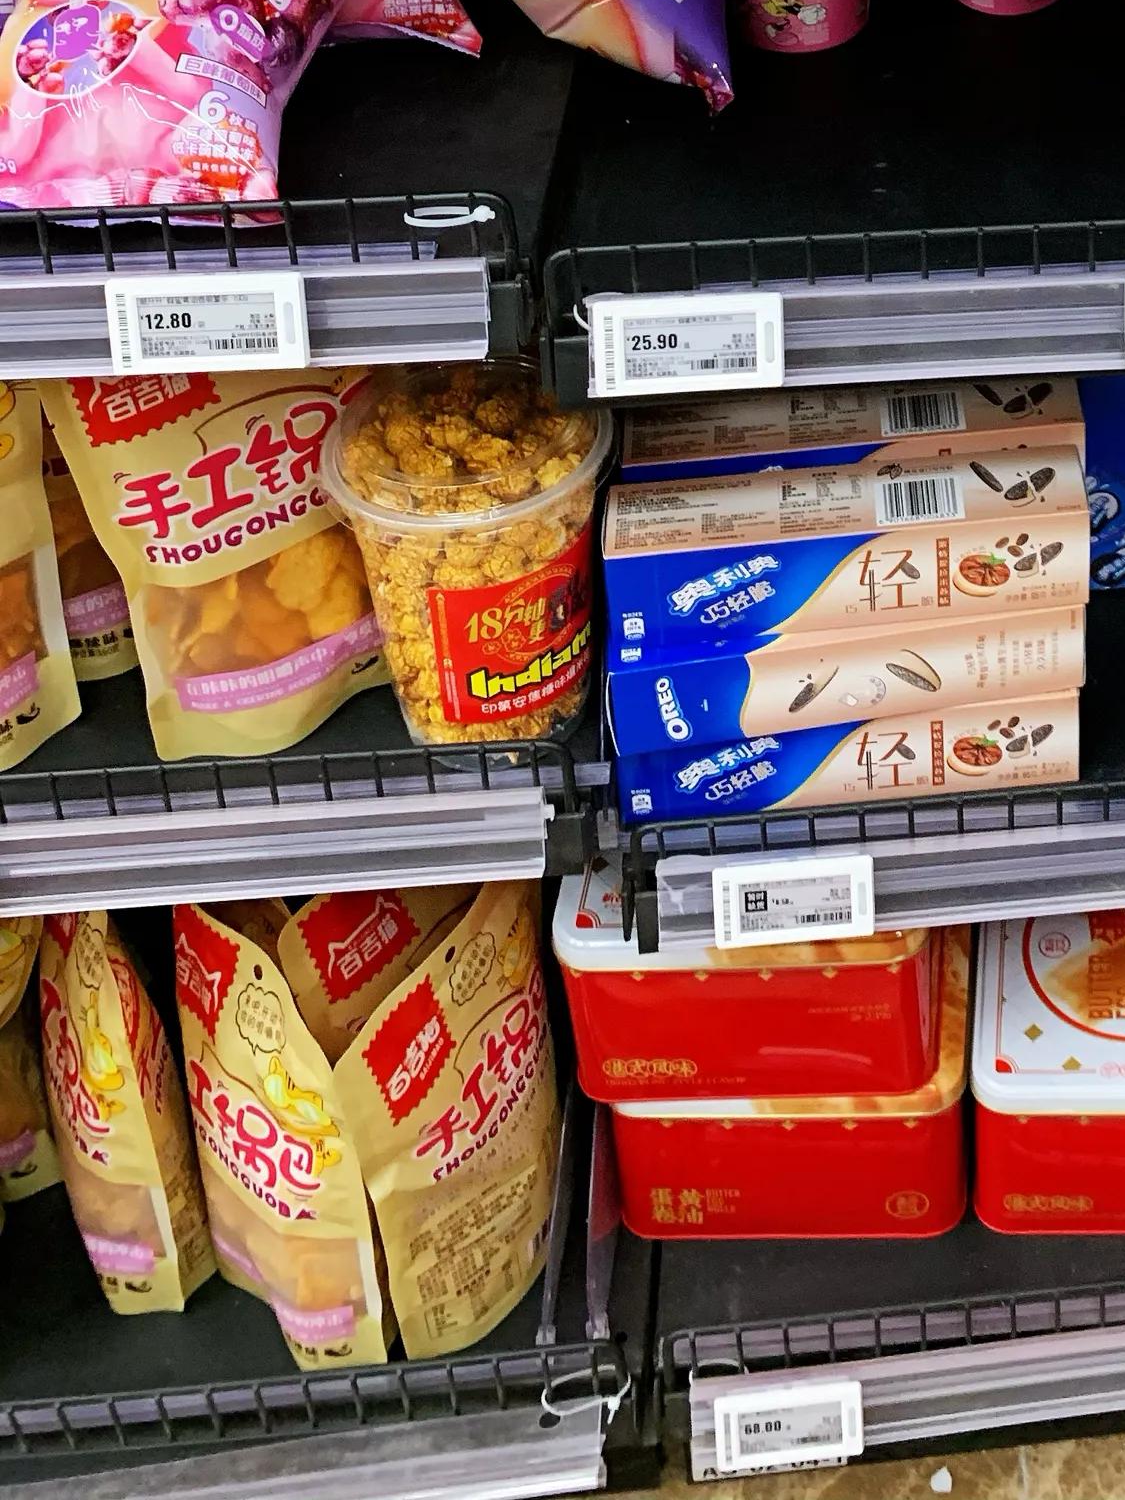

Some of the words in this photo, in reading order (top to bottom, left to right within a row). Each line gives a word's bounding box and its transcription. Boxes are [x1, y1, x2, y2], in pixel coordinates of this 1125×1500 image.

[671, 554, 780, 613] 奥利奥
[655, 677, 691, 741] OREO
[678, 737, 780, 790] 奥利奥
